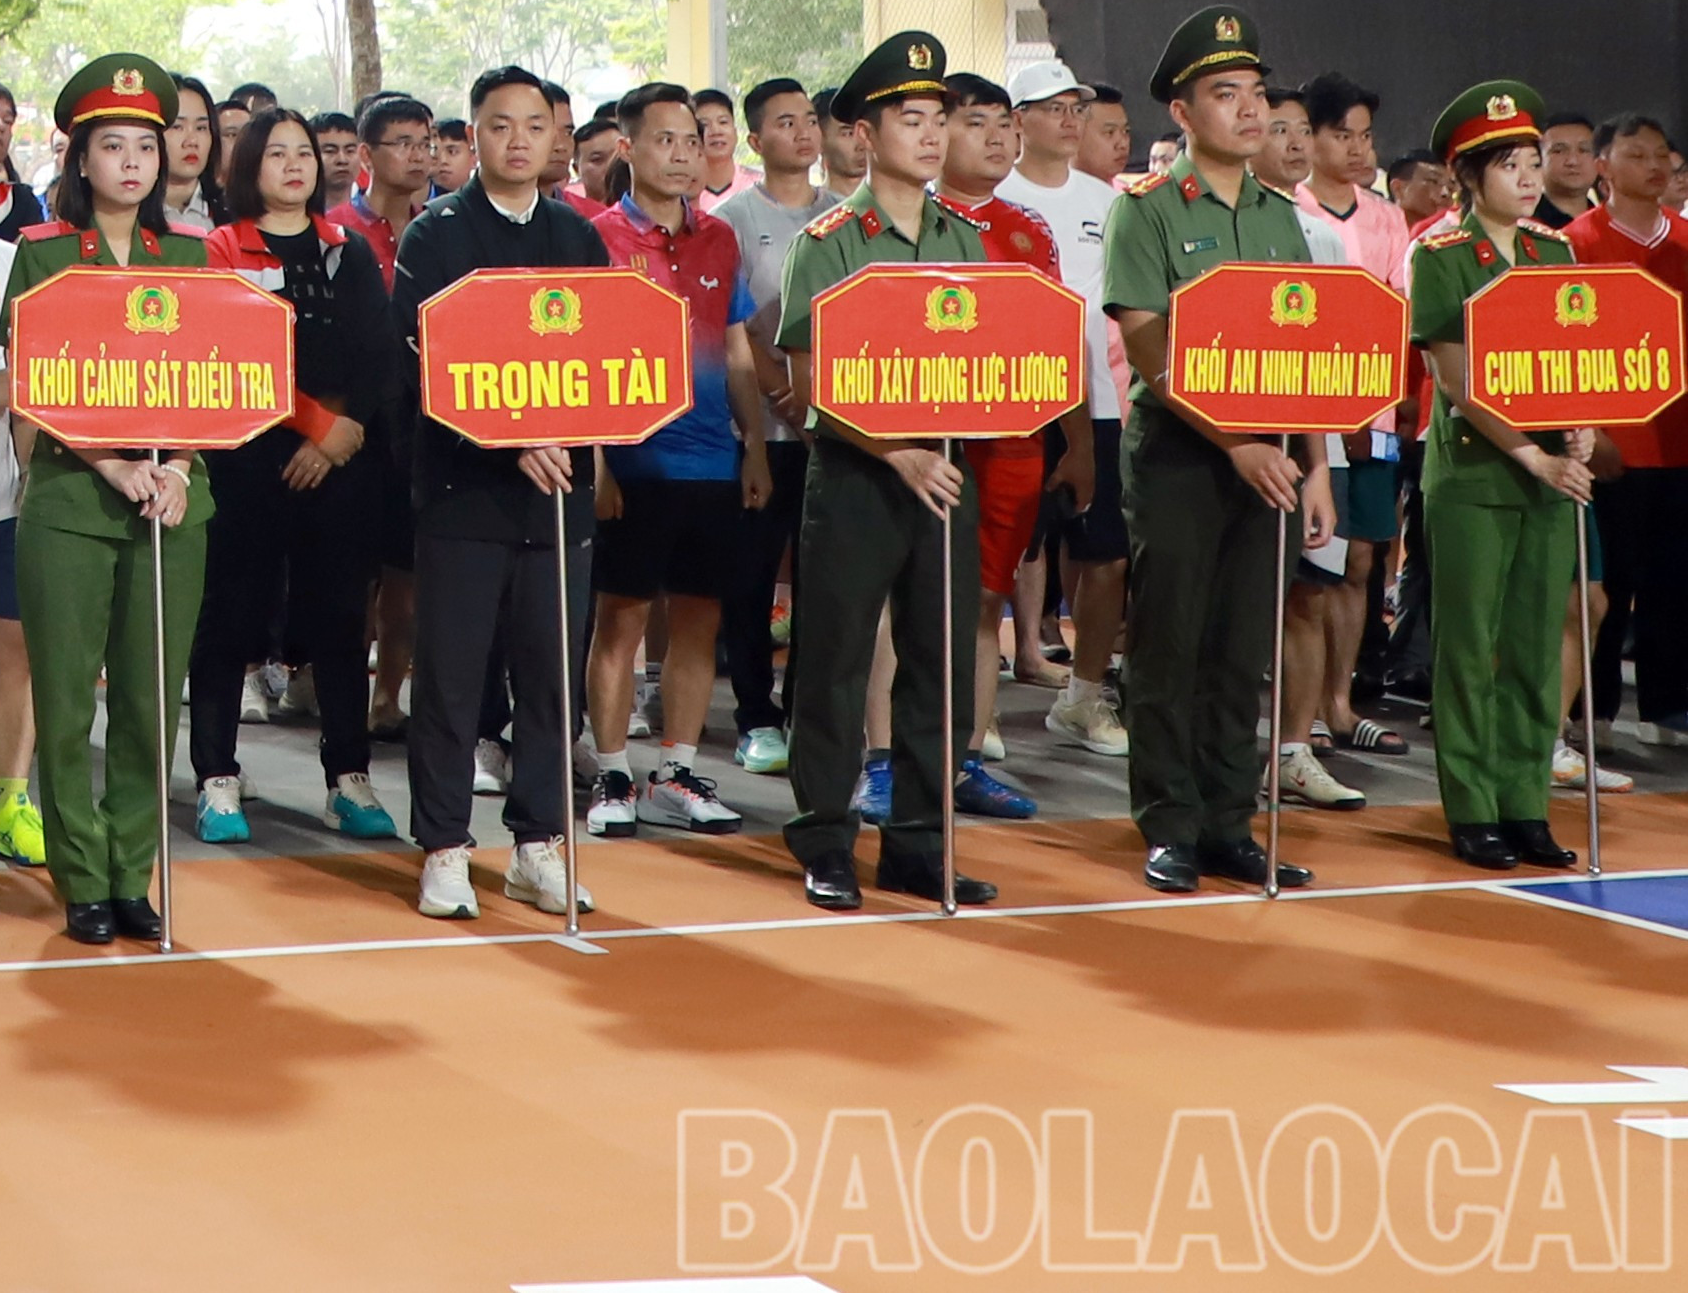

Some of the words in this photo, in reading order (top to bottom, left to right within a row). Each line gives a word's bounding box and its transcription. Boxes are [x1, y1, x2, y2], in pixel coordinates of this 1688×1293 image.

[28, 341, 78, 407] KHỐI
[81, 342, 140, 408] CẢNH
[142, 350, 183, 409] SÁT
[185, 346, 235, 410] ĐIỀU
[236, 361, 278, 410] TRA
[446, 358, 590, 420] TRỌNG
[601, 347, 668, 406] TÀI
[831, 341, 875, 404] KHỐI
[878, 347, 915, 404] XÂY
[918, 353, 969, 414] DỰNG
[972, 352, 1007, 413] LỰC
[1010, 351, 1068, 413] LƯỢNG
[1183, 332, 1227, 394] KHỐI
[1229, 348, 1257, 394] AN
[1259, 350, 1304, 396] NINH
[1306, 342, 1355, 397] NHÂN
[1357, 344, 1393, 398] DÂN
[1484, 350, 1534, 405] CỤM
[1537, 349, 1573, 394] THI
[1576, 348, 1620, 393] ĐUA
[1623, 332, 1652, 392] SỐ
[1656, 347, 1671, 391] 8
